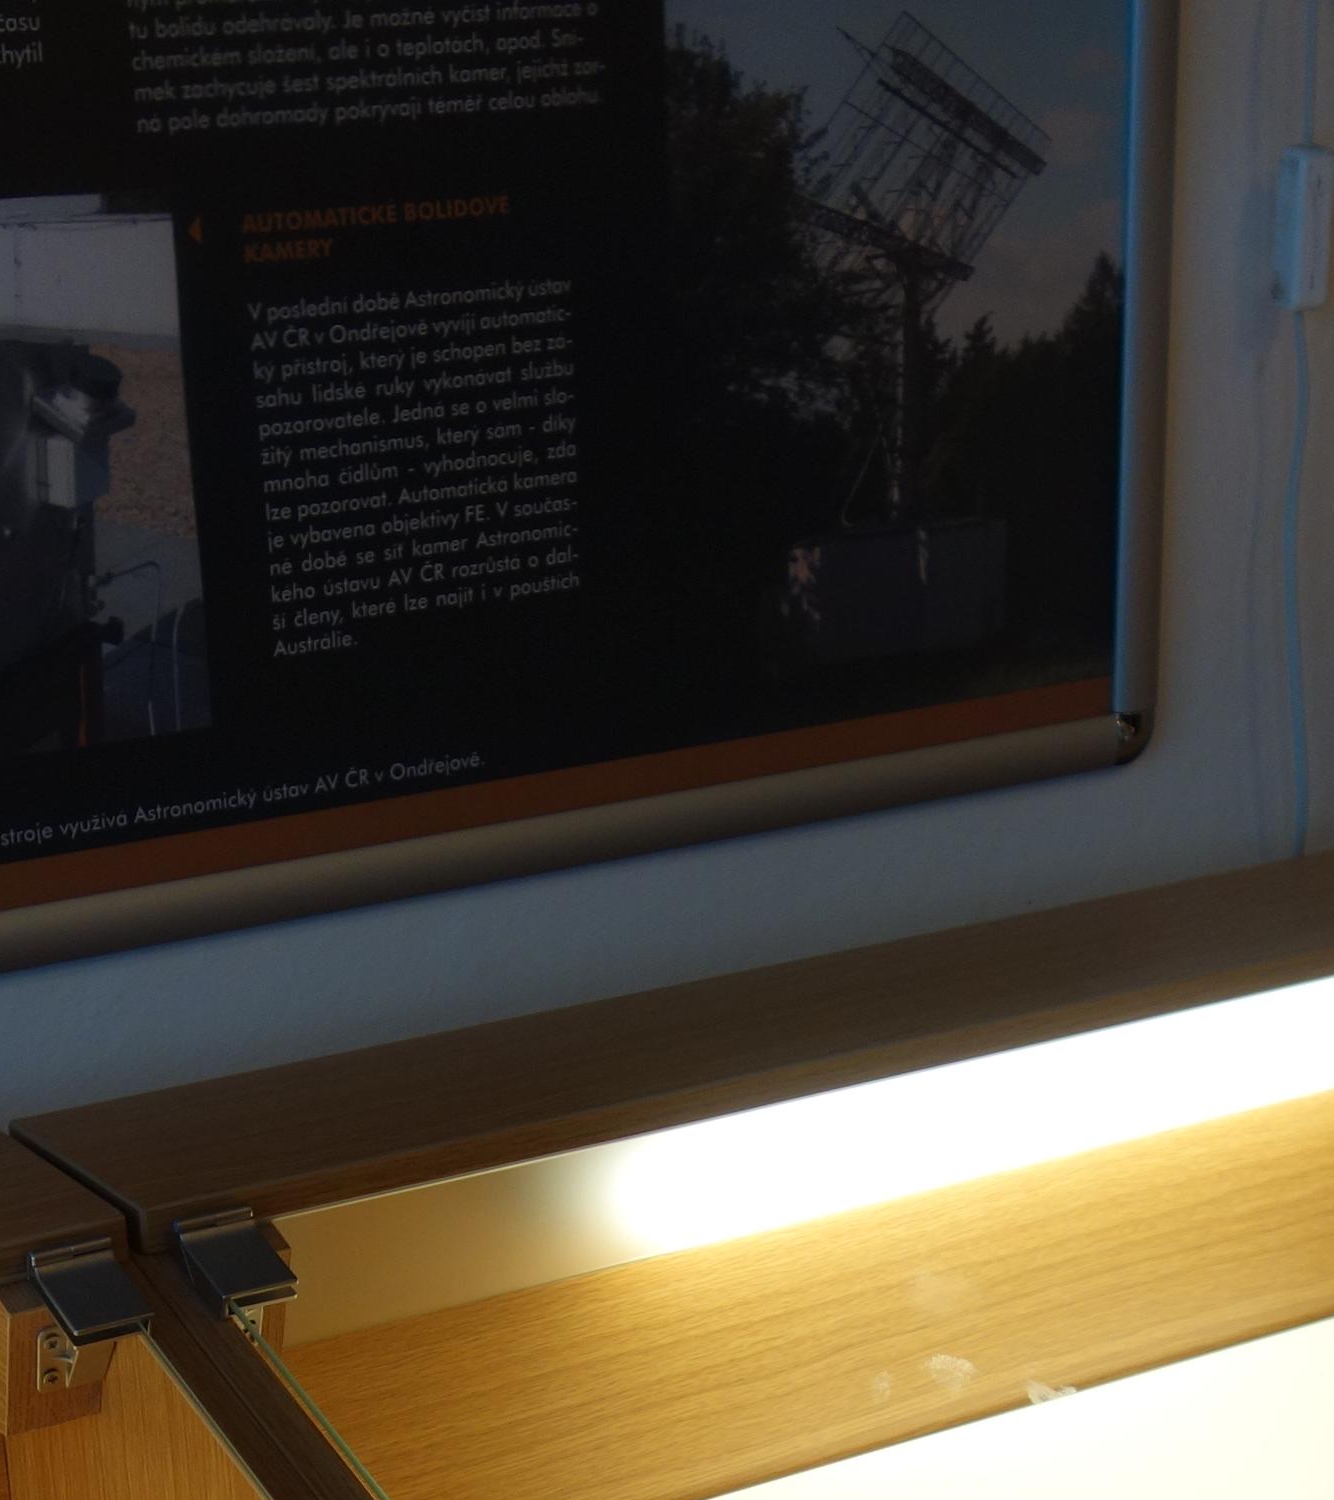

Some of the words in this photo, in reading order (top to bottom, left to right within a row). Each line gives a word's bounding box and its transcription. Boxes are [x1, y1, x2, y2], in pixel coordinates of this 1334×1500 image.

[244, 239, 331, 262] KAMERY
[250, 330, 277, 350] AV
[282, 325, 310, 347] ČR
[328, 319, 428, 343] Ondřejově
[431, 312, 475, 337] vyvíjí
[479, 304, 571, 329] automatic-
[266, 295, 347, 324] poslední
[352, 291, 400, 313] době
[404, 279, 524, 308] Astronomický
[527, 278, 571, 296] ústav
[252, 360, 275, 383] ký
[281, 352, 352, 381] přístroj,
[359, 349, 405, 370] který
[410, 346, 427, 368] je
[432, 341, 506, 362] schopen
[511, 335, 541, 354] bez
[546, 336, 573, 350] zá-
[255, 387, 301, 408] sahu
[311, 380, 366, 402] lidské
[375, 375, 414, 397] ruky
[422, 366, 511, 395] vykonávat
[520, 358, 573, 381] službu
[258, 406, 385, 441] pozorovatele.
[392, 401, 444, 423] Jedná
[492, 388, 538, 410] velmi
[543, 386, 574, 405] slo-
[260, 445, 292, 467] žitý
[299, 434, 429, 460] mechanismus,
[436, 424, 479, 446] který
[485, 423, 522, 440] sám
[541, 412, 576, 434] díky
[263, 469, 329, 492] mnoha
[338, 462, 398, 484] čidlům
[422, 445, 538, 477] vyhodnocuje,
[546, 439, 576, 459] zda
[265, 502, 291, 520] lze
[297, 491, 391, 521] pozorovat.
[397, 475, 507, 504] Automatická
[513, 470, 577, 489] kamera
[267, 530, 283, 552] je
[289, 523, 375, 549] vybavena
[381, 509, 459, 535] objektivy
[464, 503, 490, 522] FE.
[513, 497, 577, 517] součas-
[269, 558, 292, 576] né
[301, 550, 347, 571] době
[411, 537, 467, 556] kamer
[475, 520, 578, 548] Astronomic-
[270, 582, 315, 602] kého
[323, 577, 380, 596] ústavu
[451, 554, 520, 578] rozrůstá
[545, 543, 578, 565] dal-
[293, 607, 343, 627] členy,
[351, 597, 395, 618] které
[435, 586, 473, 608] najít
[509, 570, 579, 600] pouštích
[273, 630, 357, 656] Austrálie.
[58, 810, 127, 832] využívá
[135, 788, 256, 820] Astronomický
[262, 783, 309, 799] ústav
[315, 772, 338, 791] AV
[344, 766, 369, 785] ČR
[389, 751, 486, 778] Ondřejově.
